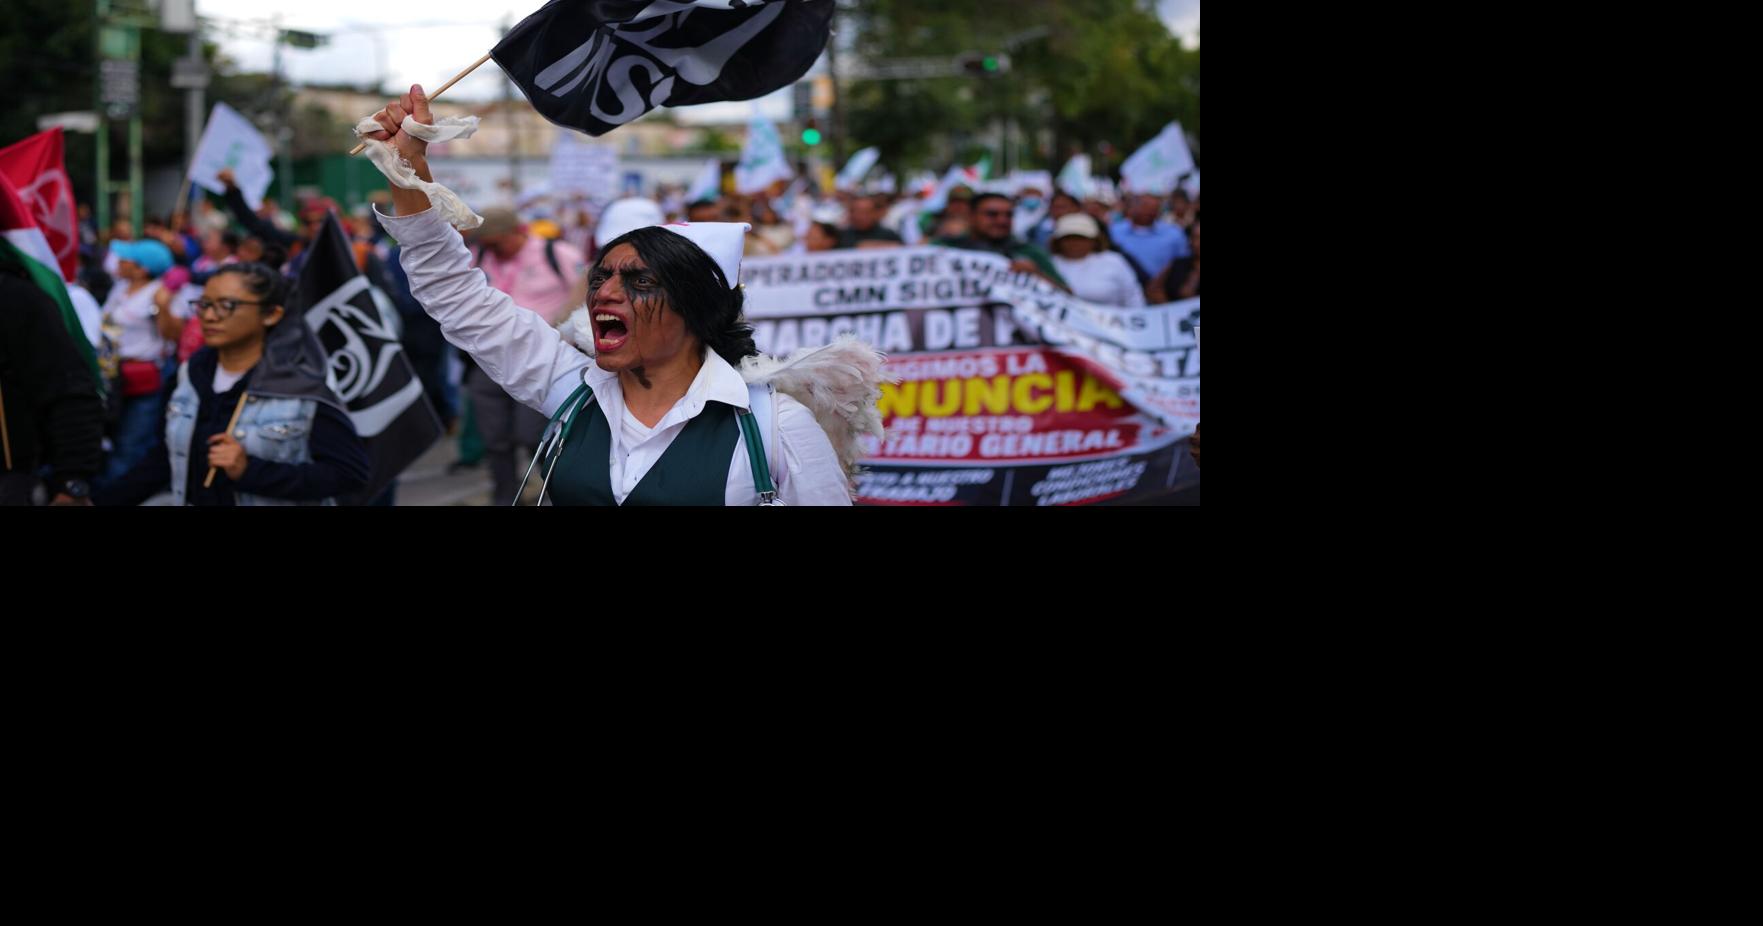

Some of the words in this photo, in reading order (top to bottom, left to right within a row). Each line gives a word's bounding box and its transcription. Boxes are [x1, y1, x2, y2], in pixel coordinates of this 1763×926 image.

[908, 255, 942, 275] DE
[813, 284, 887, 307] CMN
[923, 306, 981, 350] DE
[1006, 352, 1047, 375] LA
[877, 370, 1122, 418] NUNCIA
[925, 415, 1034, 434] NUESTRO
[978, 428, 1123, 459] GENERAL
